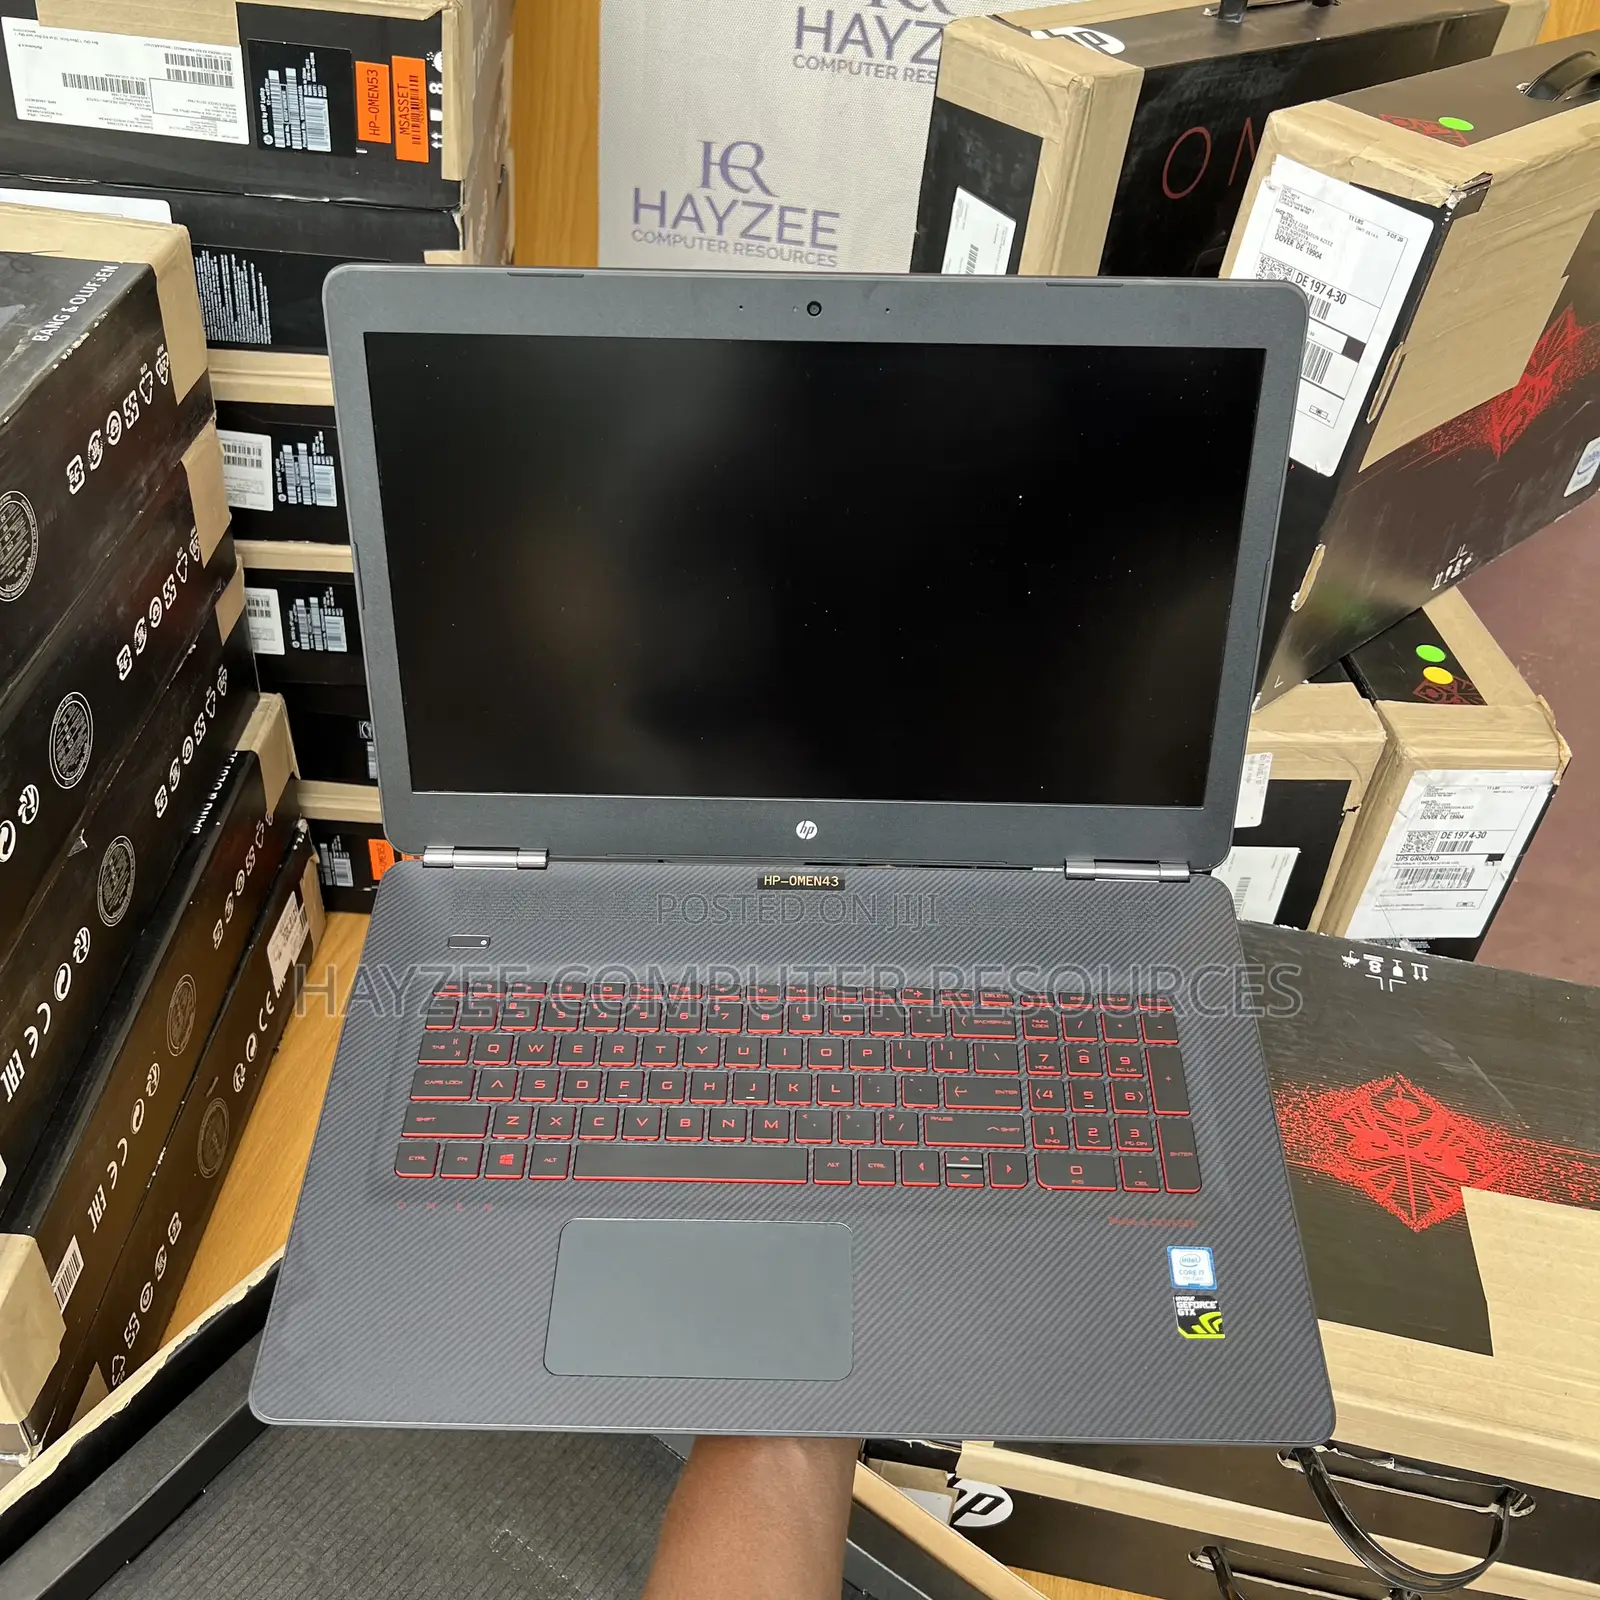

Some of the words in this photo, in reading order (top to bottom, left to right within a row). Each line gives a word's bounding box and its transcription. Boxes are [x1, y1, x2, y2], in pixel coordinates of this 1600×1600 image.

[793, 55, 898, 81] COMPUTER
[366, 69, 381, 137] HP-OMEN53
[396, 83, 411, 136] MSASSET
[633, 187, 841, 252] HAYZEE
[632, 229, 728, 254] COMPUTER
[733, 243, 838, 268] RESOURCES
[1274, 233, 1295, 247] DOVER
[1295, 242, 1305, 251] DE
[1305, 247, 1323, 260] 19904
[69, 265, 119, 305] OLUFSEN
[1294, 272, 1310, 287] DE
[1308, 279, 1326, 296] 197
[1325, 287, 1348, 306] 4-30
[61, 305, 79, 313] &
[32, 314, 71, 342] BANG
[764, 875, 839, 886] HP-OMEN43
[557, 1011, 566, 1019] 3
[802, 1014, 811, 1022] 9
[488, 1044, 500, 1053] Q
[528, 1045, 544, 1053] W
[573, 1045, 584, 1053] E
[614, 1046, 625, 1054] R
[656, 1046, 666, 1054] T
[738, 1047, 750, 1055] U
[820, 1048, 832, 1057] O
[863, 1049, 873, 1057] P
[1039, 1054, 1049, 1063] 7
[1079, 1055, 1090, 1064] 8
[1119, 1056, 1131, 1065] 9
[535, 1080, 546, 1089] S
[577, 1081, 589, 1089] D
[662, 1082, 673, 1090] G
[704, 1083, 715, 1091] H
[750, 1083, 756, 1091] J
[789, 1083, 799, 1092] K
[1083, 1091, 1094, 1100] 5
[1124, 1092, 1136, 1101] 6
[506, 1116, 520, 1125] Z
[550, 1117, 563, 1125] X
[593, 1118, 605, 1126] C
[636, 1118, 649, 1126] V
[680, 1119, 691, 1127] B
[722, 1119, 735, 1128] N
[764, 1120, 779, 1128] M
[1048, 1126, 1055, 1135] 1
[1088, 1127, 1098, 1137] 2
[1130, 1128, 1140, 1138] 3
[1179, 1268, 1197, 1276] CORE
[1176, 1301, 1217, 1309] GEFORCE
[1177, 1308, 1197, 1316] GTX
